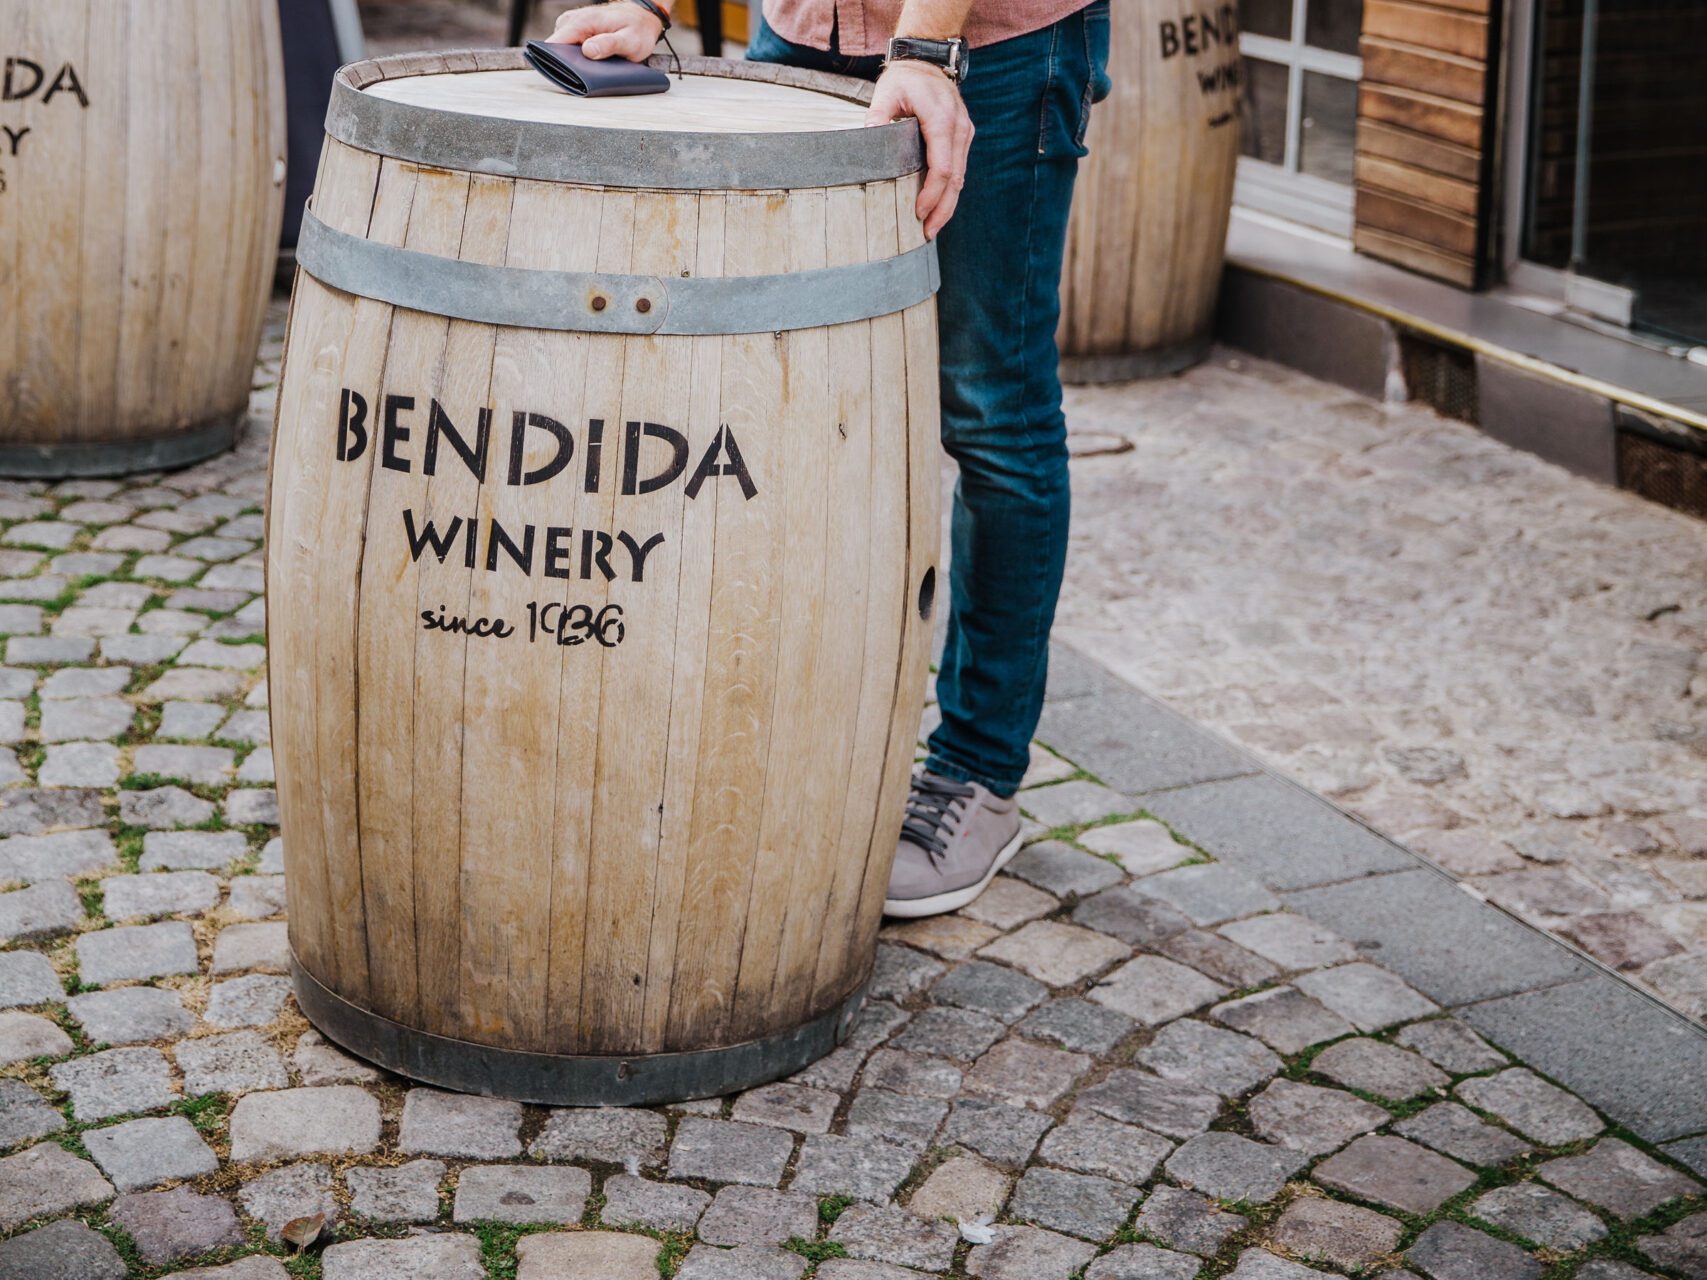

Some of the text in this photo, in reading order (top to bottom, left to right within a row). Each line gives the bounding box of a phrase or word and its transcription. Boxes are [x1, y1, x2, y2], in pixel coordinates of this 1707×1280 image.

[0, 125, 31, 156] Y
[336, 387, 759, 501] BENDIDA
[402, 508, 666, 583] WINERY
[420, 600, 625, 648] since 1936
